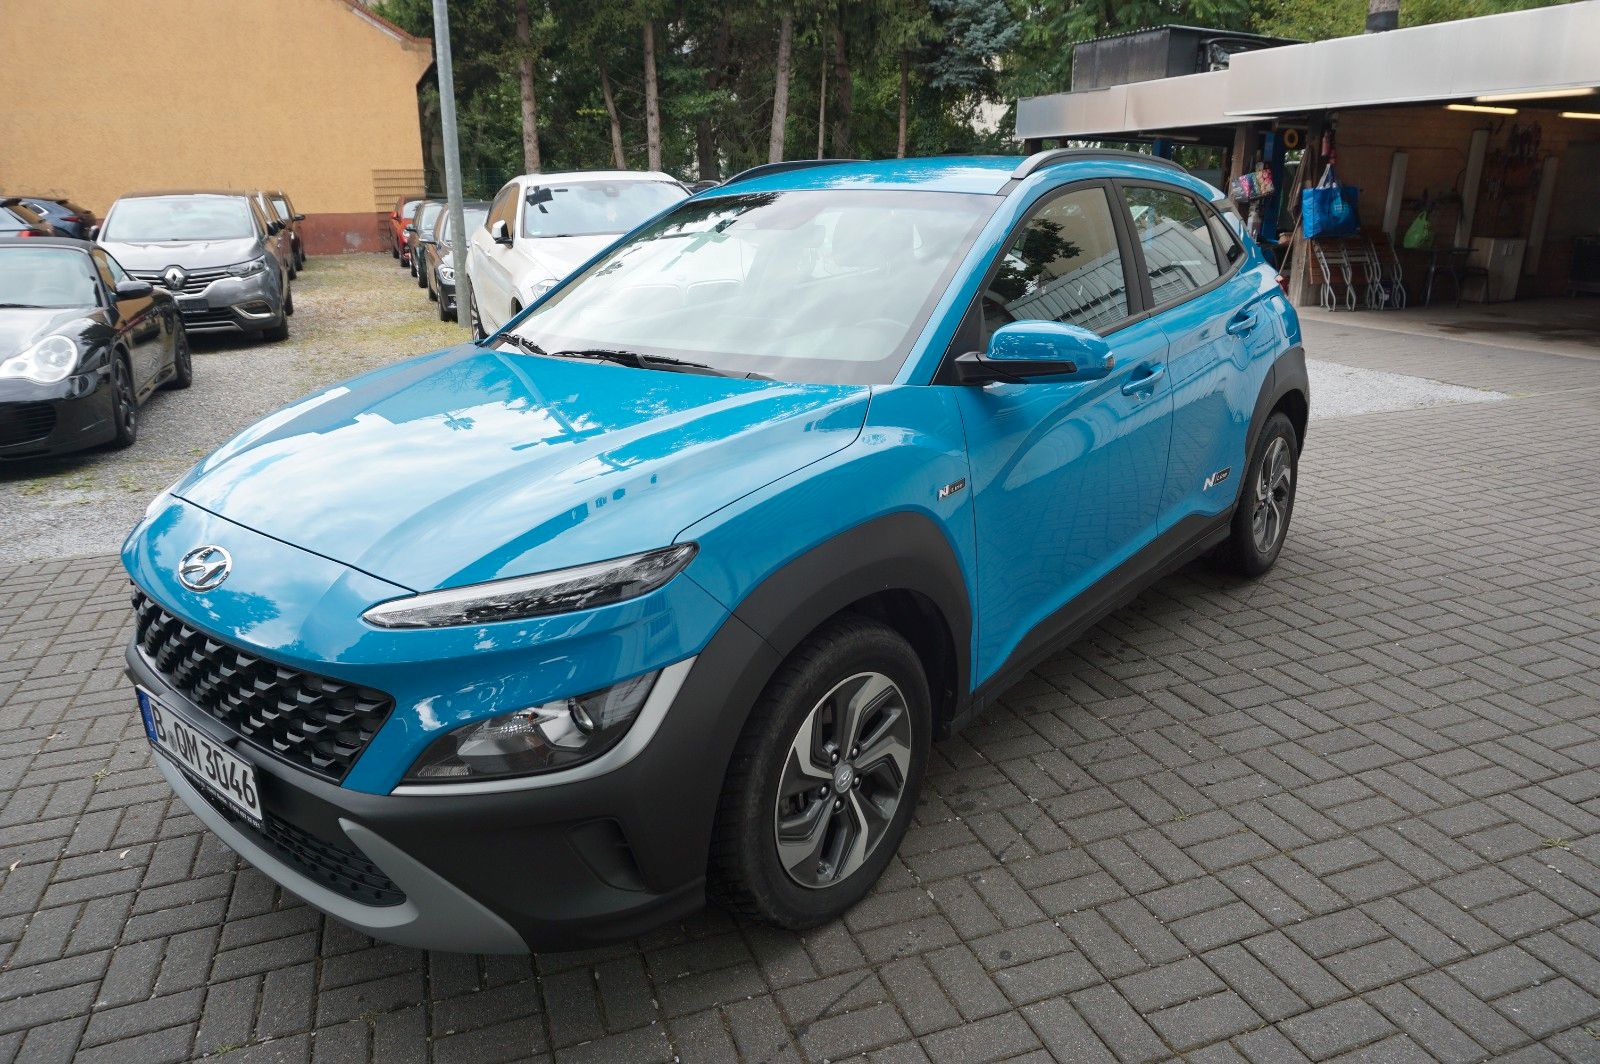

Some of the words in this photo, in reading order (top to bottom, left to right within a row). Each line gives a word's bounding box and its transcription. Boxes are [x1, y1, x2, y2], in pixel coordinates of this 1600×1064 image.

[151, 704, 167, 742] B
[174, 721, 202, 771] QM
[201, 741, 256, 809] 3046
